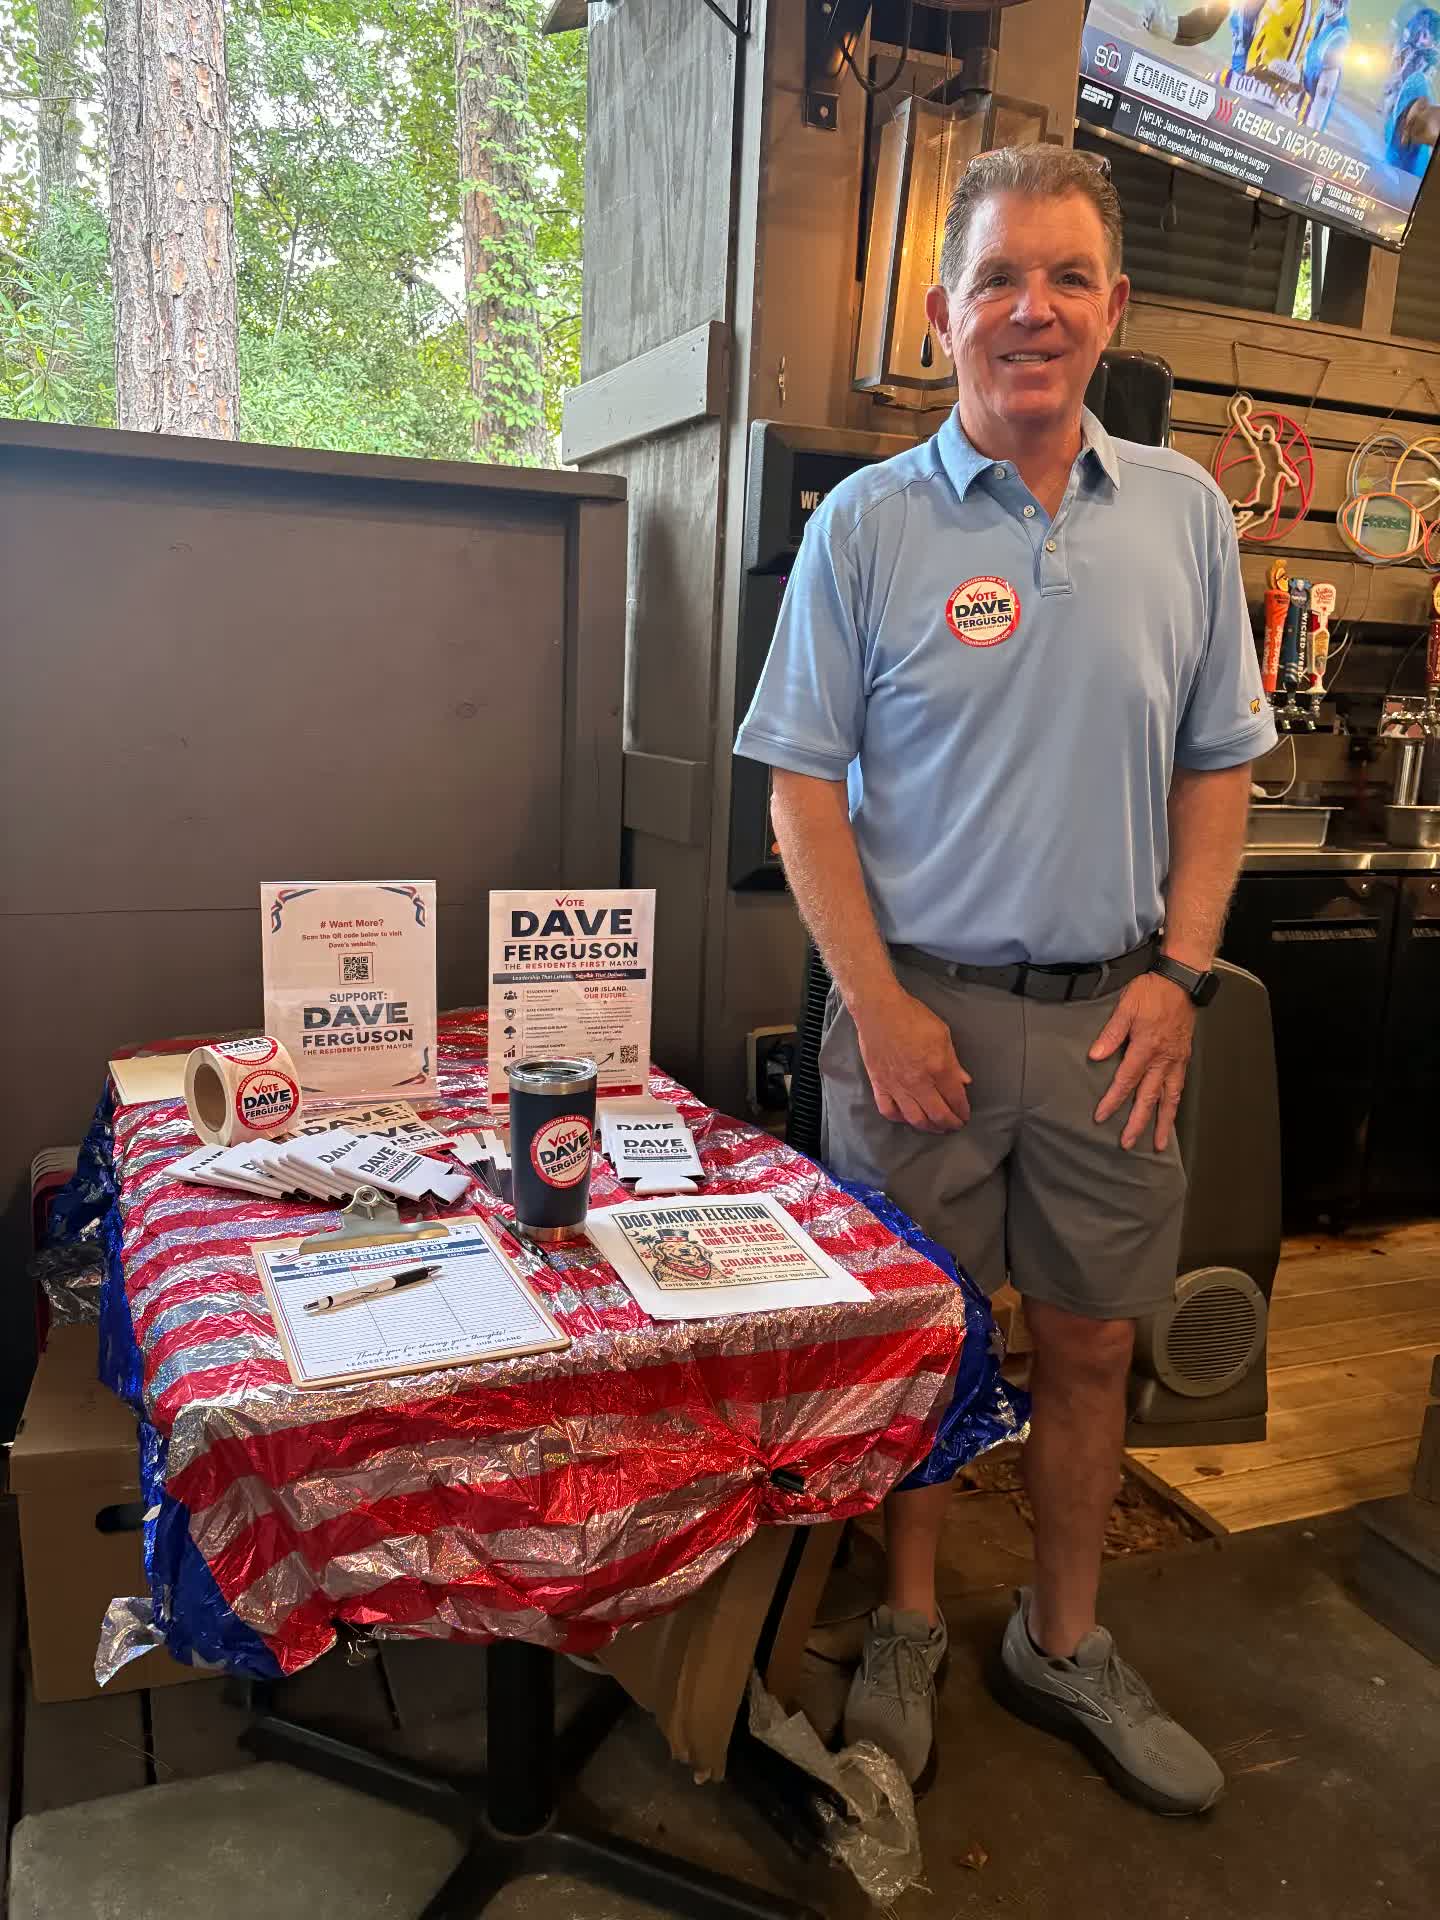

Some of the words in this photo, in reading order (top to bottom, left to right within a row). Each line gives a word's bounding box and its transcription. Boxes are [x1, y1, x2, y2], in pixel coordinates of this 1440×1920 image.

[1080, 83, 1114, 110] ESPN
[1133, 62, 1188, 103] COMING
[1189, 86, 1210, 110] UP
[1232, 108, 1285, 146] REBELS
[1281, 129, 1320, 163] NEXT
[1339, 156, 1371, 185] TEST
[1141, 110, 1163, 128] NFLN:
[1163, 120, 1187, 140] Jaxson
[1187, 129, 1201, 144] Dart
[1201, 134, 1209, 146] to
[1209, 140, 1234, 157] undergo
[1234, 149, 1248, 162] knee
[1248, 157, 1271, 173] surgery
[1138, 126, 1157, 142] Giants
[1157, 133, 1168, 146] QB
[1167, 140, 1193, 157] expected
[1193, 148, 1200, 159] to
[1199, 152, 1213, 164] miss
[1212, 158, 1240, 174] remainder
[1239, 167, 1246, 178] of
[1245, 172, 1264, 184] season
[966, 584, 998, 603] VOTE
[955, 599, 1012, 618] DAVE
[957, 615, 1012, 629] FERGUSON
[1299, 612, 1308, 649] WICKED
[555, 894, 585, 907] VOTE
[328, 920, 352, 928] Want
[355, 918, 384, 927] More?
[511, 909, 633, 937] DAVE
[504, 941, 638, 961] FERGUSON
[525, 962, 577, 970] RESIDENTS
[580, 960, 607, 968] FIRST
[609, 959, 639, 967] MAYOR
[329, 991, 388, 1003] SUPPORT:
[303, 1002, 409, 1029] DAVE
[219, 1039, 268, 1050] DAVE
[302, 1029, 413, 1048] FERGUSON
[319, 1046, 362, 1055] RESIDENTS
[252, 1079, 279, 1094] VOTE
[243, 1089, 292, 1109] DAVE
[245, 1103, 292, 1118] FERGUSON
[299, 1106, 399, 1136] DAVE
[548, 1128, 579, 1147] VOTE
[623, 1139, 684, 1147] DAVE
[540, 1130, 590, 1165] DAVE
[358, 1146, 398, 1174] DAVE
[375, 1151, 409, 1178] FERGUSON
[545, 1145, 591, 1176] FERGUSON
[618, 1213, 653, 1230] DOG
[651, 1209, 705, 1228] MAYOR
[701, 1205, 771, 1221] ELECTION
[695, 1228, 720, 1238] THE
[719, 1225, 752, 1236] RACE
[750, 1223, 777, 1234] HAS
[702, 1237, 729, 1246] GONE
[726, 1236, 739, 1244] TO
[740, 1234, 760, 1243] THE
[758, 1232, 789, 1242] DOGS!
[316, 1250, 360, 1260] MAYOR
[326, 1249, 407, 1263] LISTENING
[411, 1243, 449, 1253] STOP
[720, 1256, 769, 1268] COLIGNY
[768, 1253, 808, 1264] BEACH
[345, 1355, 400, 1367] LEADERSHIP
[417, 1345, 461, 1356] INTEGRITY
[352, 1349, 384, 1360] Thank
[386, 1347, 401, 1357] you
[403, 1344, 416, 1354] for
[418, 1340, 449, 1349] sharing
[450, 1336, 469, 1345] your
